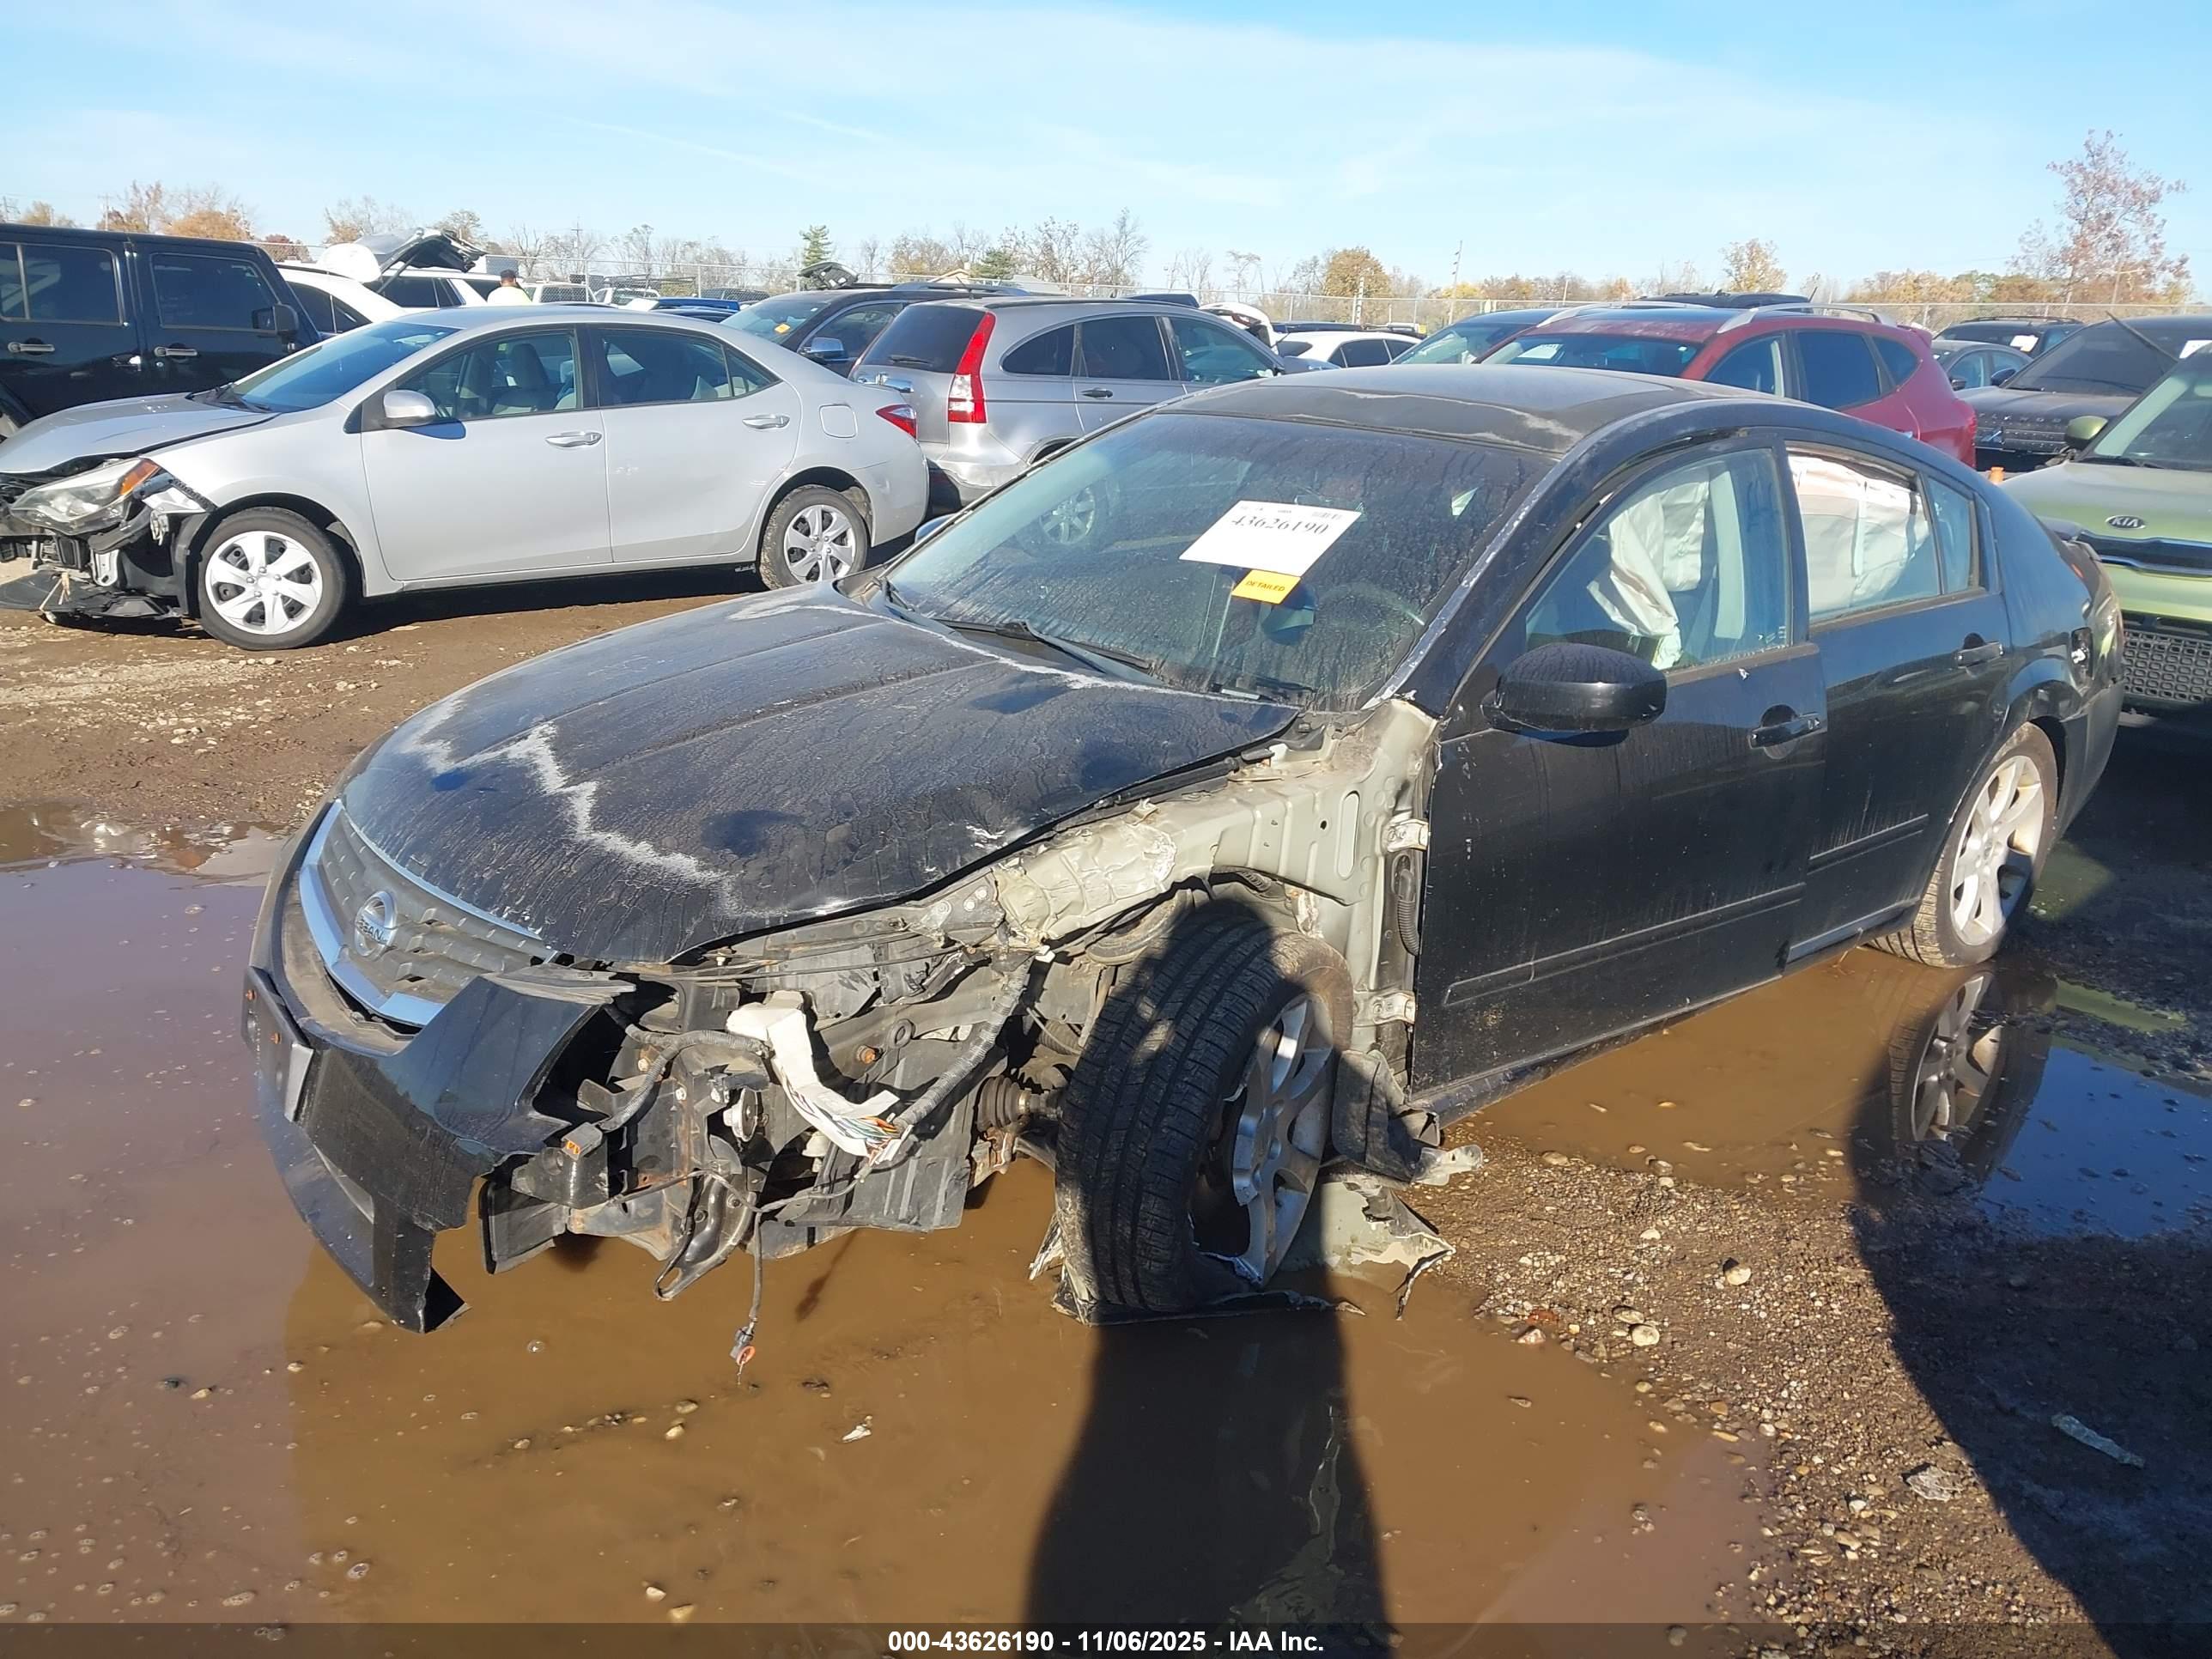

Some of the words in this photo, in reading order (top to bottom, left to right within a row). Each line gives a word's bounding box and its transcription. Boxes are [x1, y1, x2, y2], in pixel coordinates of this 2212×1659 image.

[1231, 515, 1329, 534] 43626190
[2112, 517, 2138, 527] KIA
[1245, 580, 1285, 592] DETAILED
